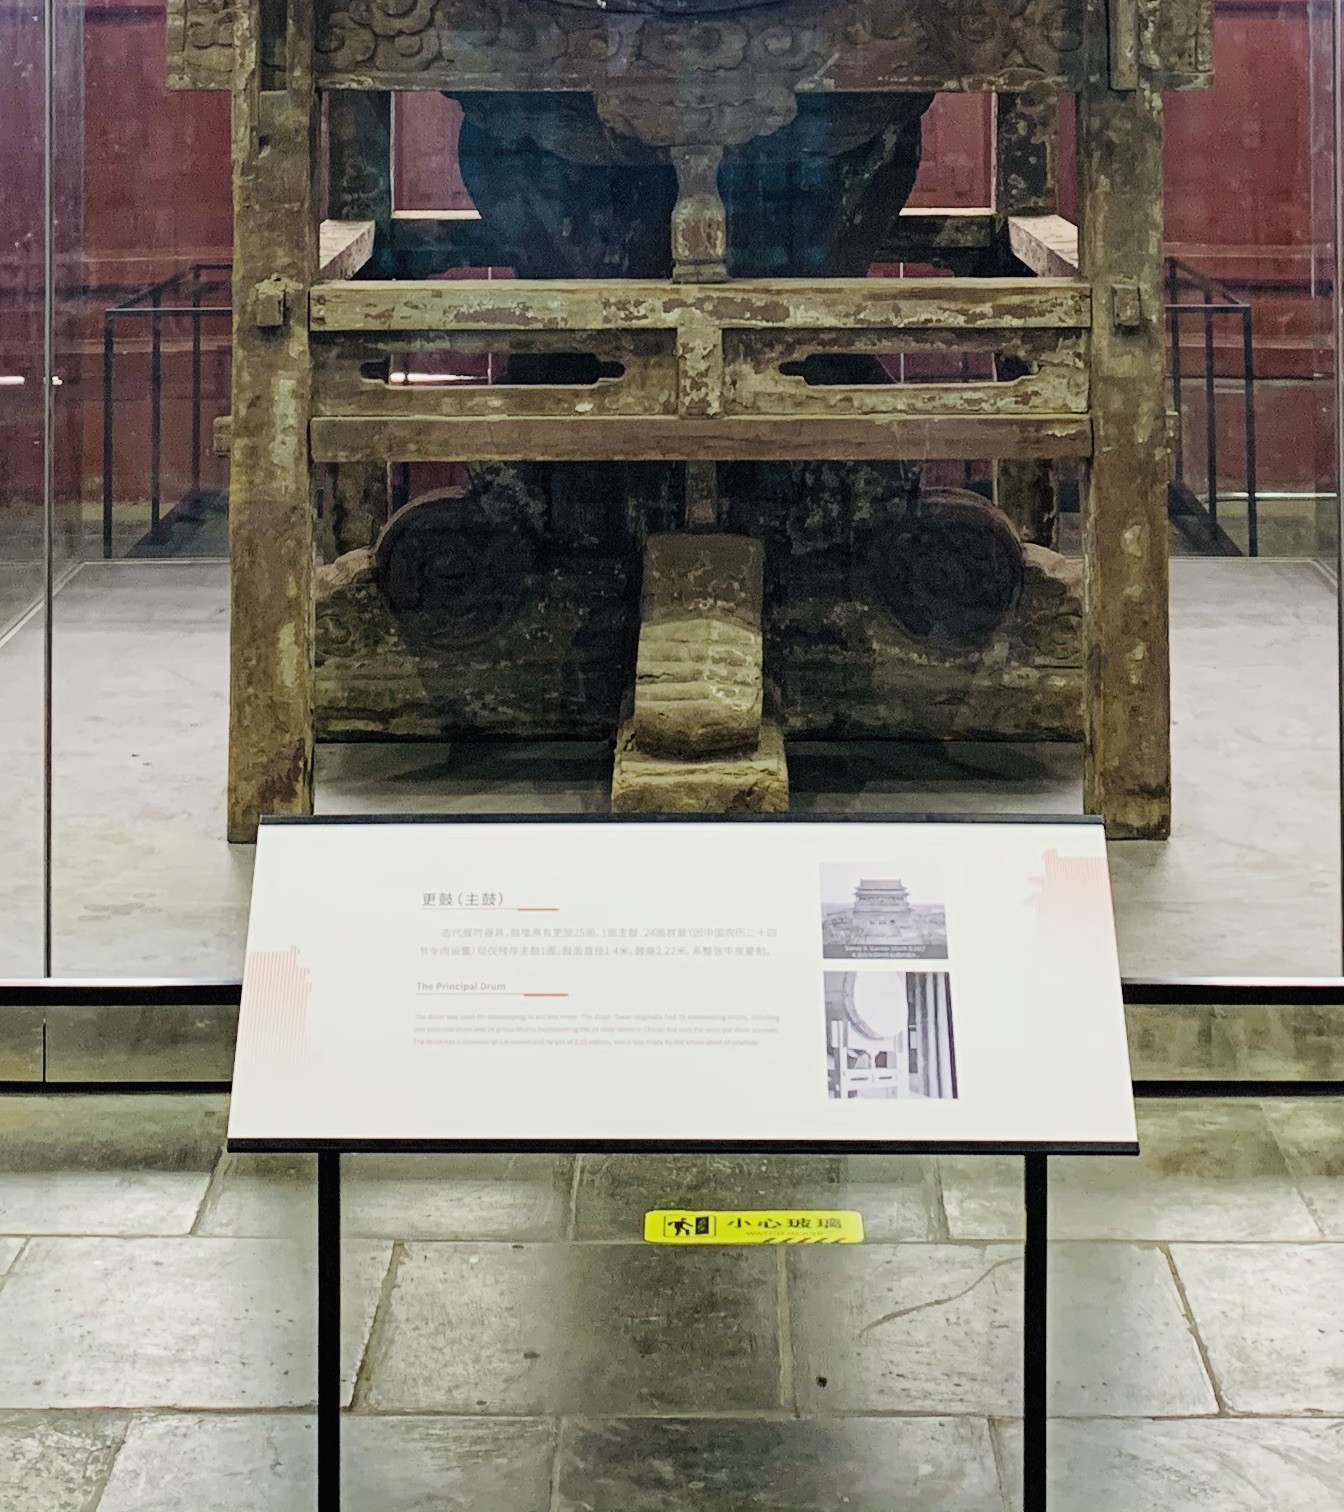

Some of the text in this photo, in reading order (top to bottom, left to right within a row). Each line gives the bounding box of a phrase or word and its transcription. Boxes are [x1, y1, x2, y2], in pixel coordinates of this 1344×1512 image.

[416, 982, 506, 992] The Principal Drum
[727, 1217, 842, 1229] 小心玻璃
